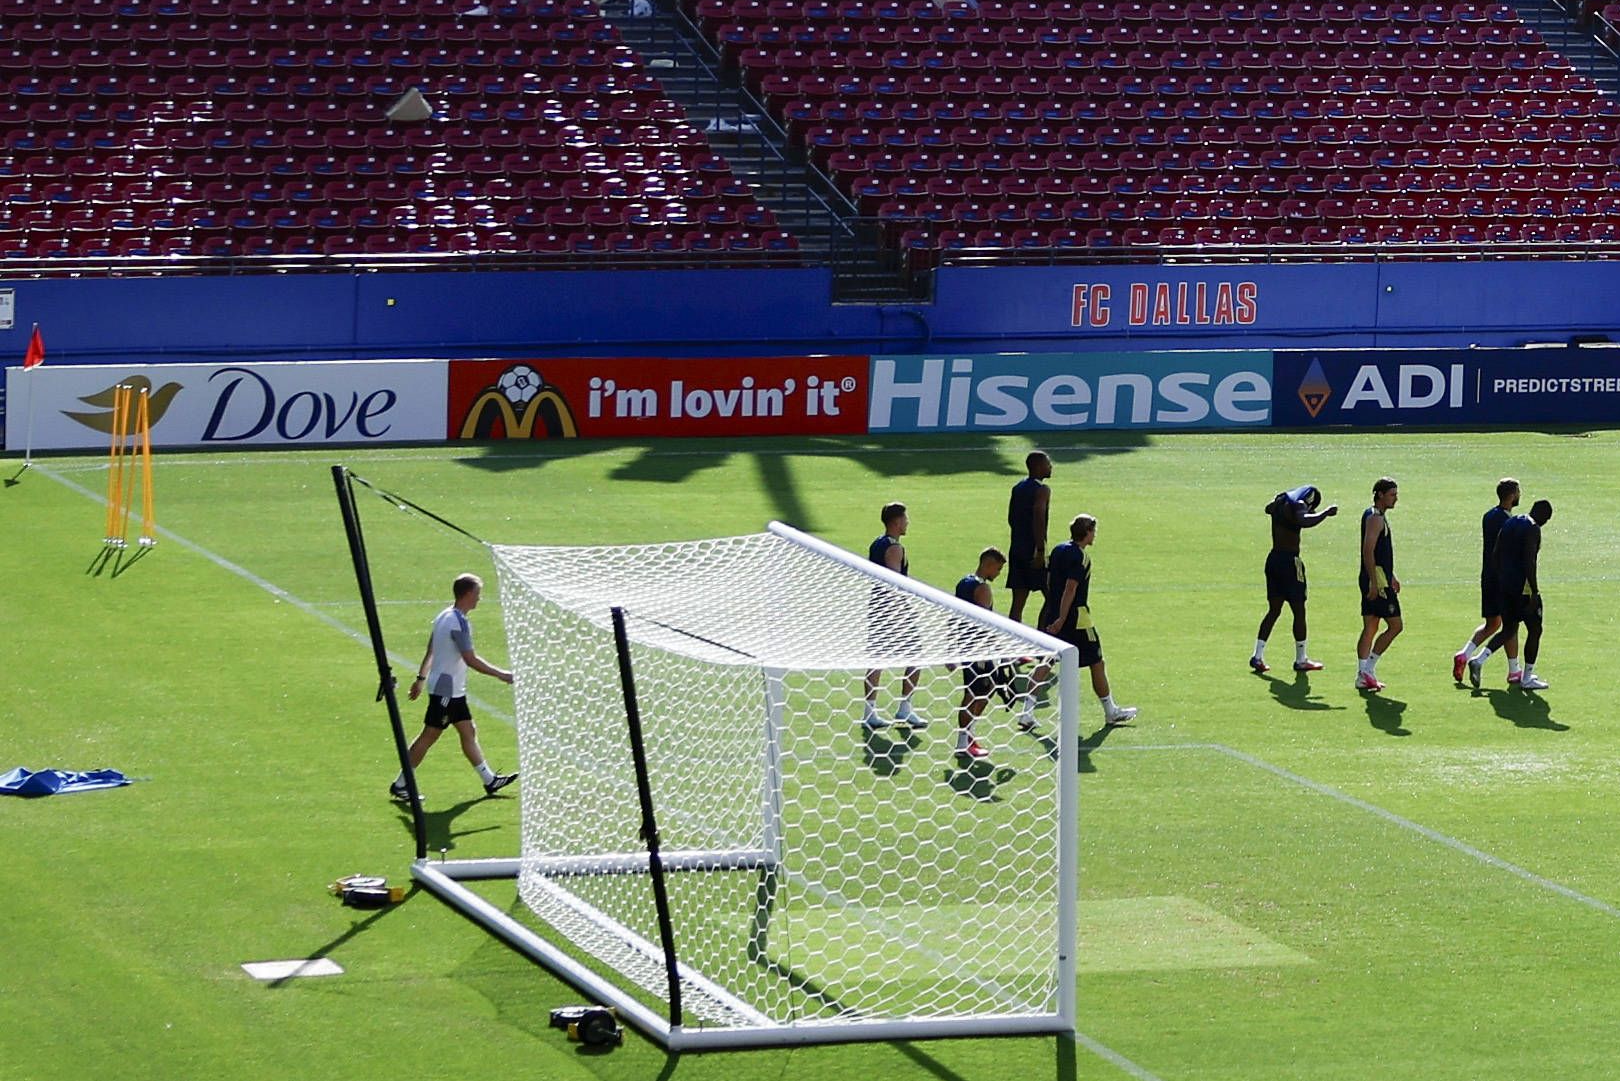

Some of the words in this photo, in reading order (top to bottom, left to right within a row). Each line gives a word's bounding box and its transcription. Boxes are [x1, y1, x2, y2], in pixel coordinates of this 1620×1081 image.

[1071, 283, 1111, 327] FC
[1129, 282, 1257, 325] DALLAS
[201, 367, 397, 441] Dove
[588, 376, 657, 418] i'm
[670, 376, 796, 418] lovin'
[868, 358, 1273, 429] Hisense
[1341, 364, 1464, 409] ADI
